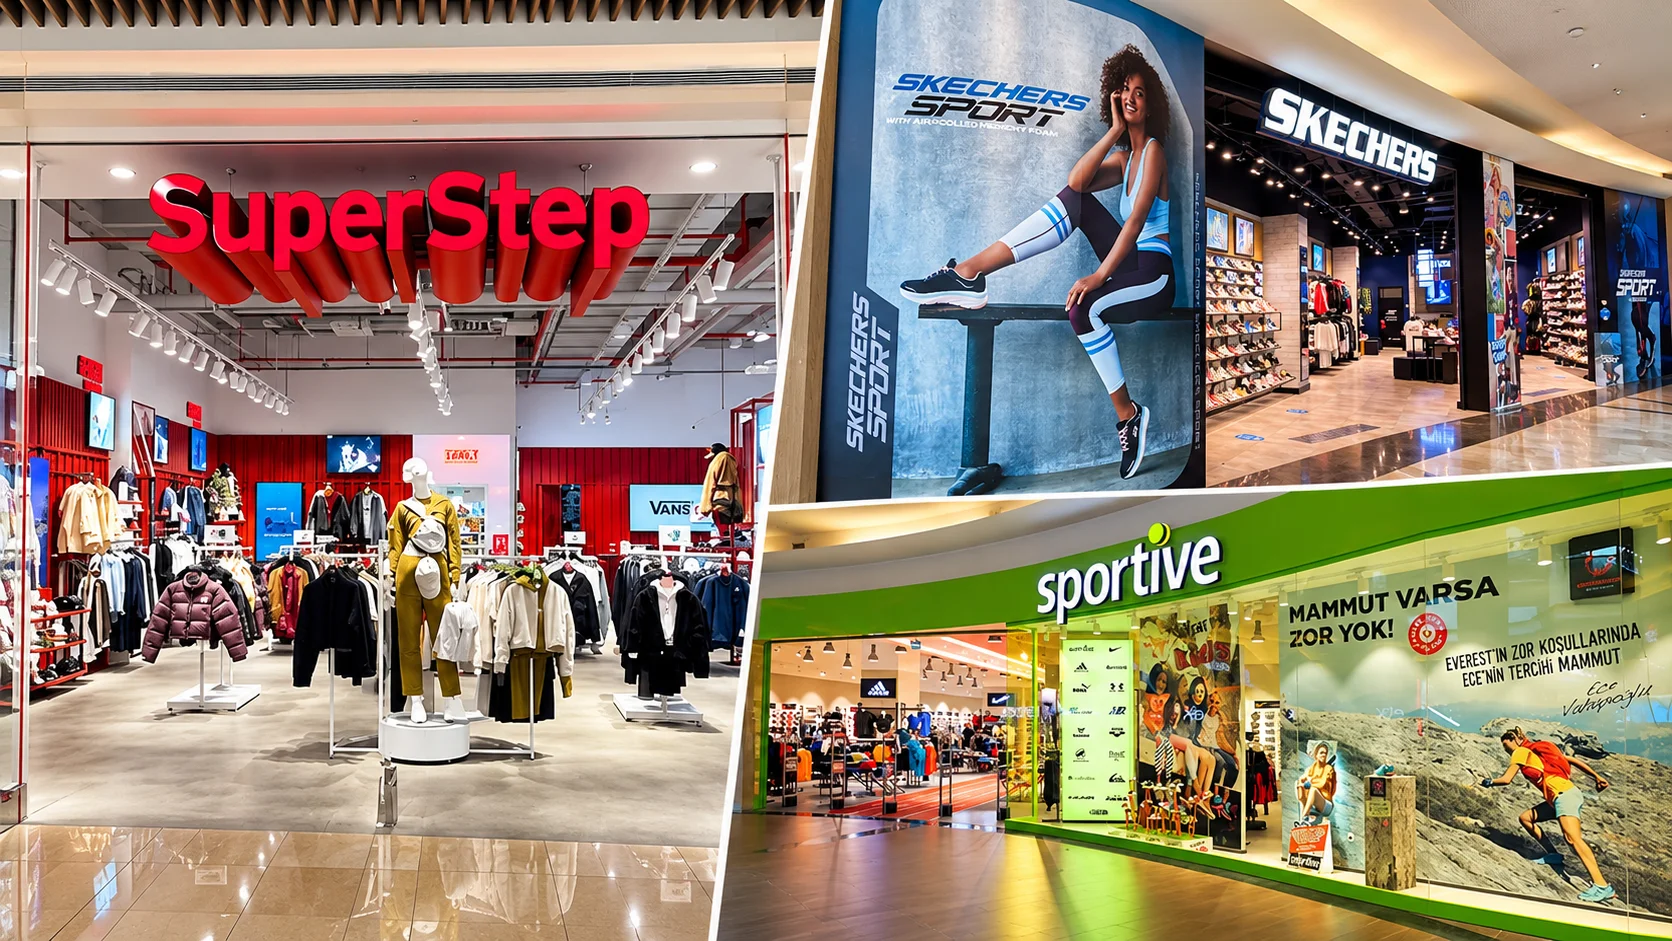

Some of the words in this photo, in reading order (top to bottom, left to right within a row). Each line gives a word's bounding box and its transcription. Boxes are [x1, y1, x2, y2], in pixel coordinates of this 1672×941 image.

[892, 73, 1091, 112] SKECHERS
[904, 95, 1065, 128] SPORT
[1264, 87, 1438, 183] SKECHERS
[147, 170, 651, 272] SuperStep
[1616, 278, 1657, 297] SPORT
[846, 291, 870, 453] SKECHERS
[867, 315, 891, 444] SPORT
[649, 500, 691, 515] VANS
[1037, 522, 1222, 624] sportive
[1289, 592, 1390, 624] MAMMUT
[1395, 575, 1500, 610] VARSA
[1289, 626, 1334, 648] ZOR
[1338, 618, 1394, 644] YOK!
[1511, 641, 1535, 660] ZOR
[1539, 622, 1641, 655] KOŞULLARINDA
[1558, 647, 1620, 672] MAMMUT
